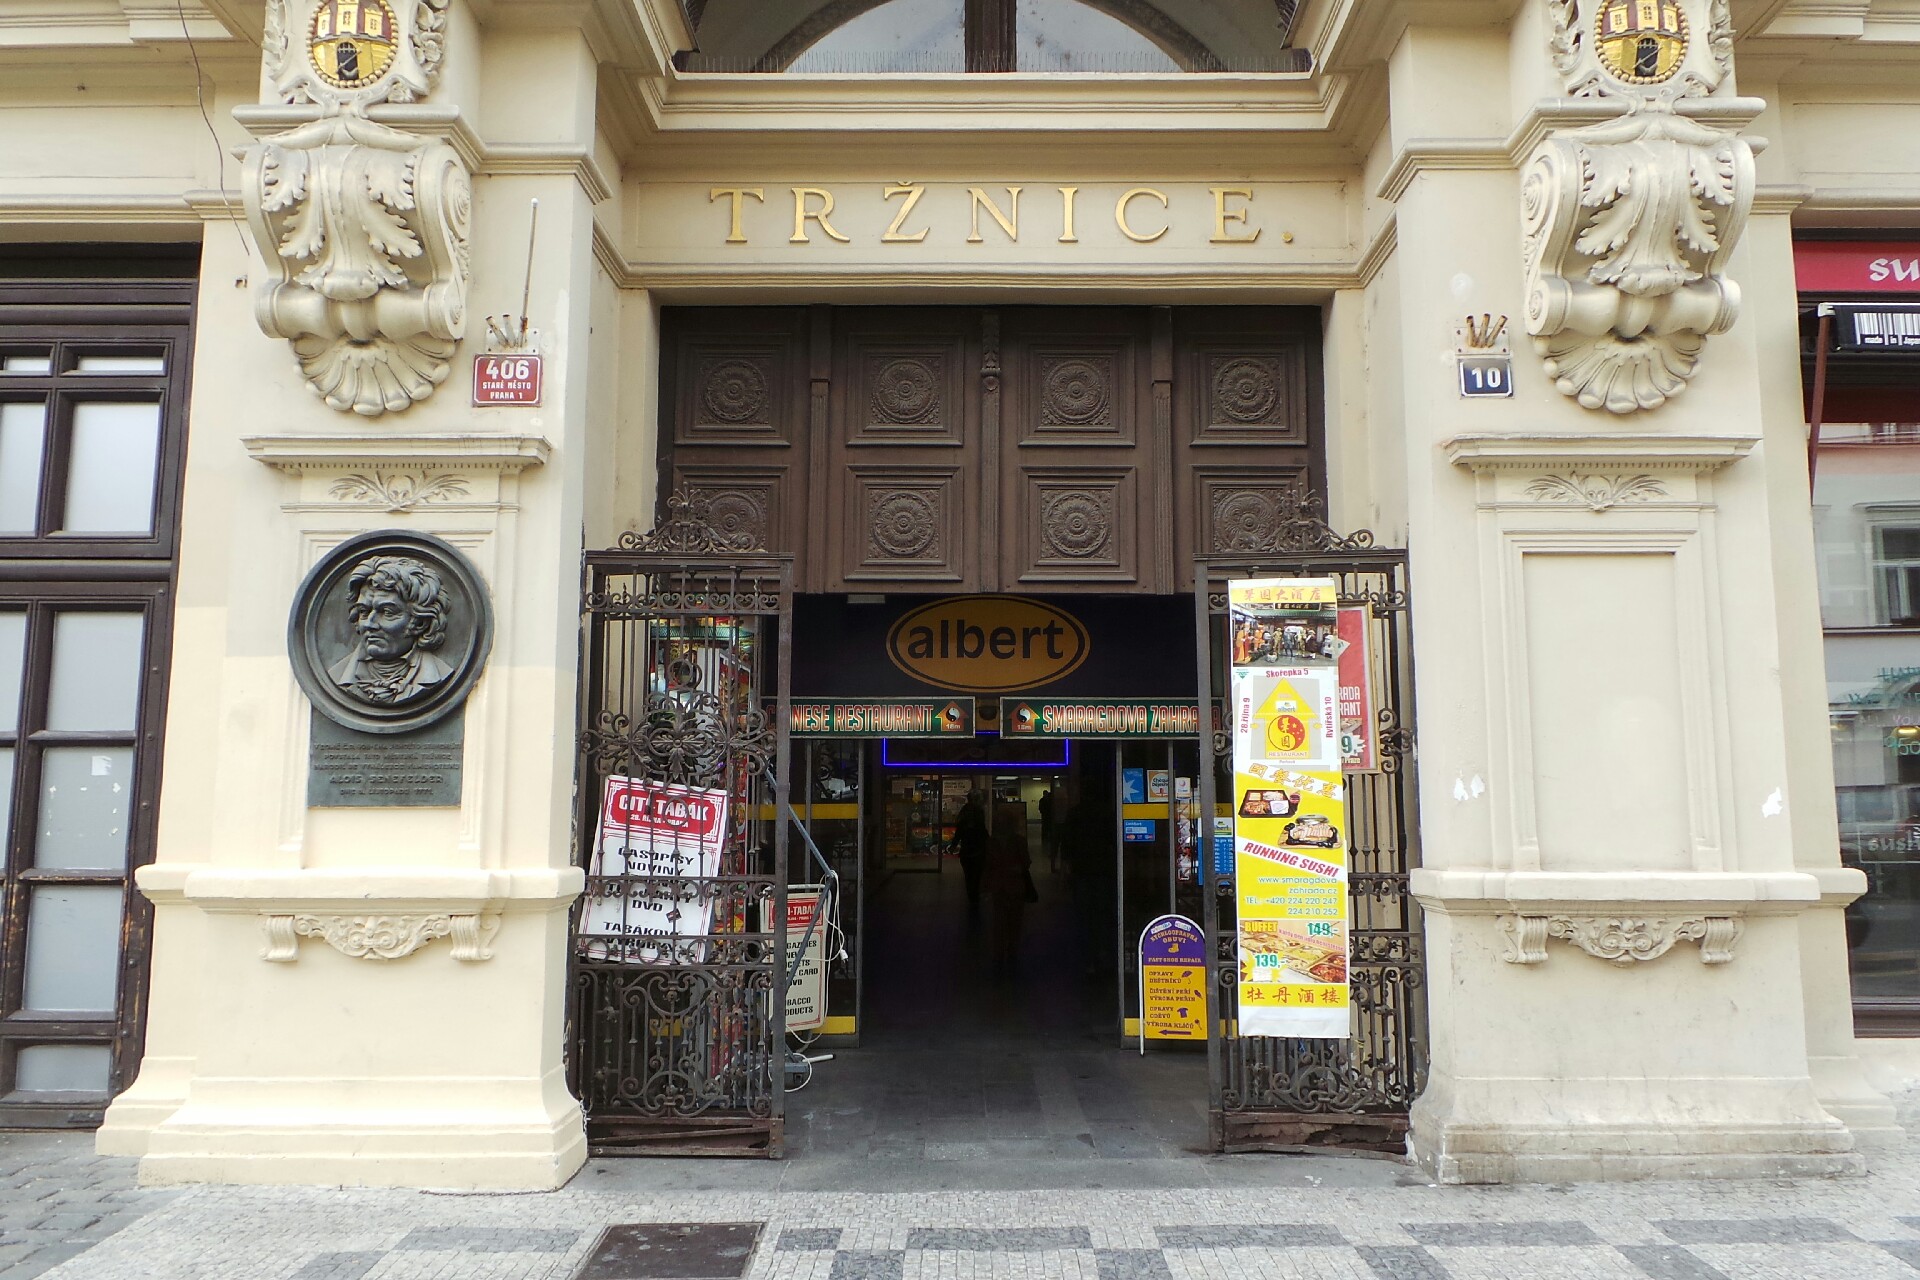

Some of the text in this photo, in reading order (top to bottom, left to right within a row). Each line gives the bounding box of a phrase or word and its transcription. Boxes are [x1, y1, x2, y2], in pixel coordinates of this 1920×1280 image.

[486, 359, 529, 380] 406
[1471, 367, 1501, 389] 10
[482, 380, 532, 390] STARÉ MĚSTO
[489, 391, 523, 400] PRAHA 1
[907, 619, 1064, 660] albert
[1303, 667, 1309, 676] 5
[833, 704, 934, 733] RESTAURANT
[1243, 842, 1299, 866] RUNNING
[1299, 858, 1339, 878] SUSHI
[1258, 877, 1337, 885] www.smaragdova
[1289, 887, 1337, 895] zahrada.cz
[631, 899, 663, 912] DVD
[1265, 897, 1285, 905] +420
[1288, 897, 1302, 905] 224
[1305, 897, 1320, 905] 220
[1323, 897, 1337, 905] 247
[1288, 908, 1337, 916] 224 210 252
[1244, 920, 1278, 933] BUFFET
[1162, 936, 1186, 944] OBUVI
[798, 968, 818, 976] CARD
[1246, 986, 1341, 1004] 牡丹酒楼
